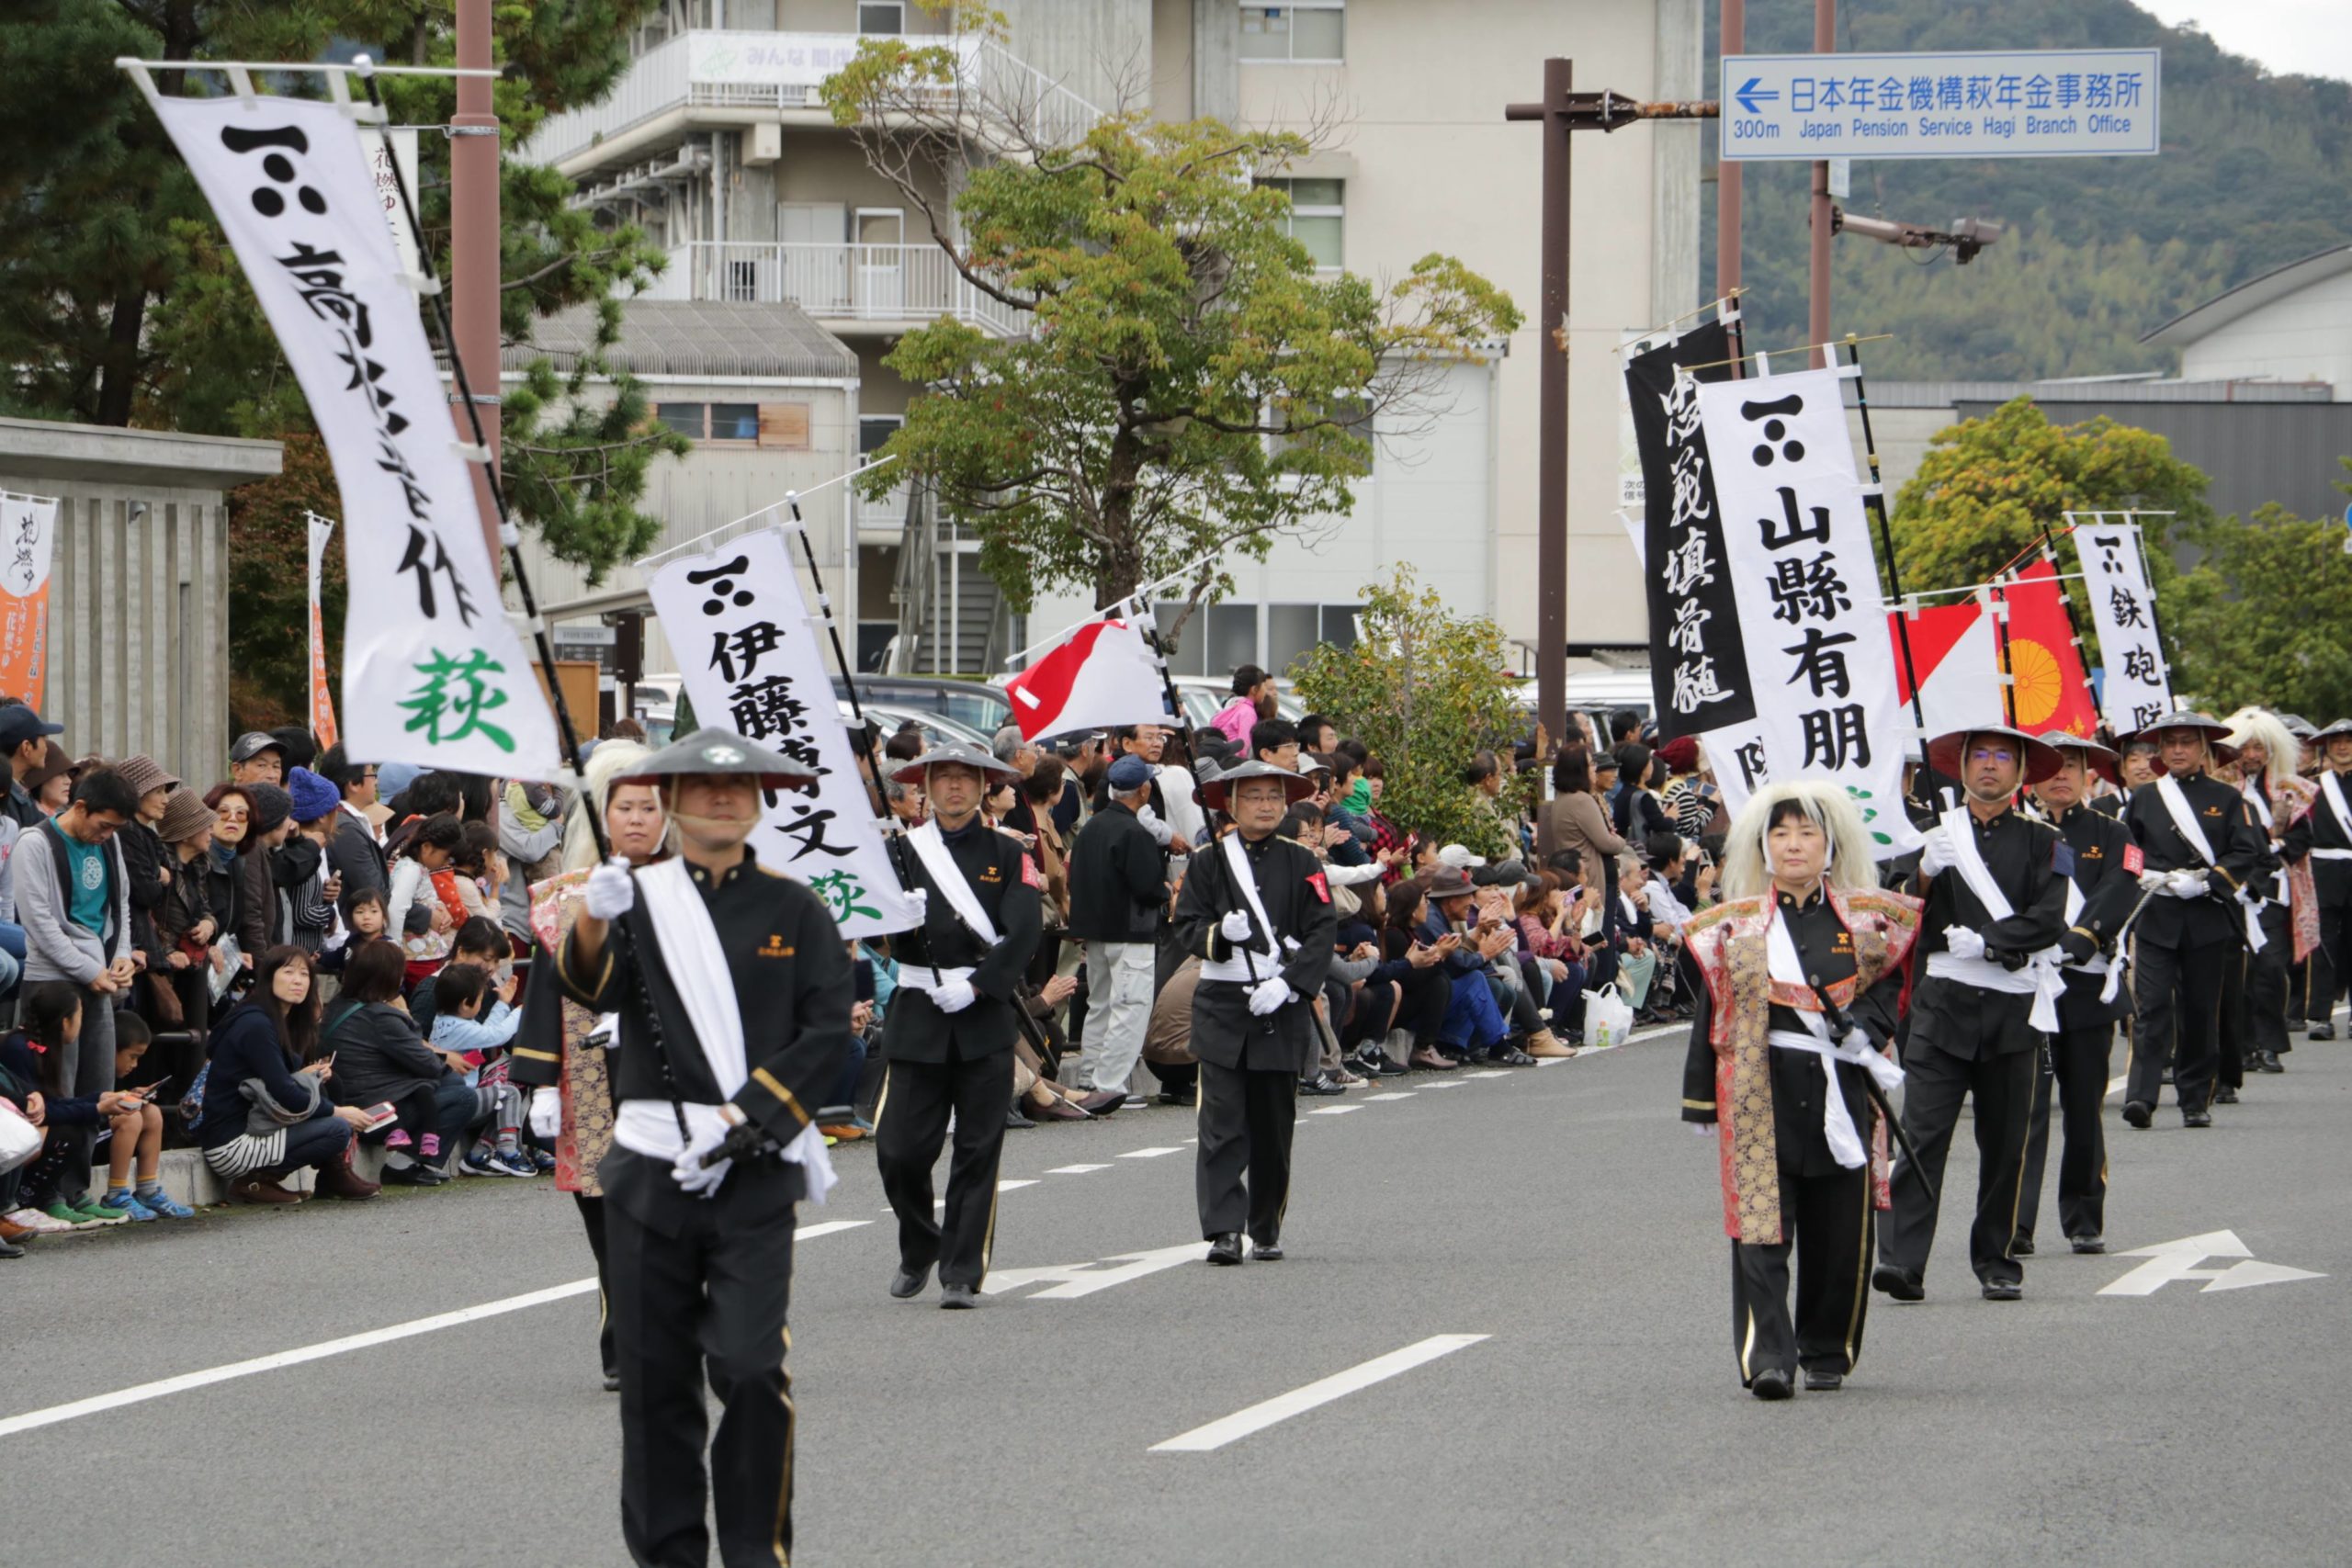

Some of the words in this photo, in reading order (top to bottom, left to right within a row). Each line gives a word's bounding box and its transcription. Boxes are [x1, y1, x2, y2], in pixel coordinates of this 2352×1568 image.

[1791, 72, 2143, 113] 日本年金機構萩年金事務所
[1733, 119, 1781, 140] 300m
[1799, 118, 1842, 141] Japan
[1852, 118, 1908, 138] Pension
[1918, 117, 1973, 137] Service
[1983, 116, 2016, 140] Hagi
[2026, 115, 2077, 135] Branch
[2087, 113, 2132, 134] Office
[1757, 486, 1871, 772] 山縣有朋
[396, 647, 517, 755] 萩
